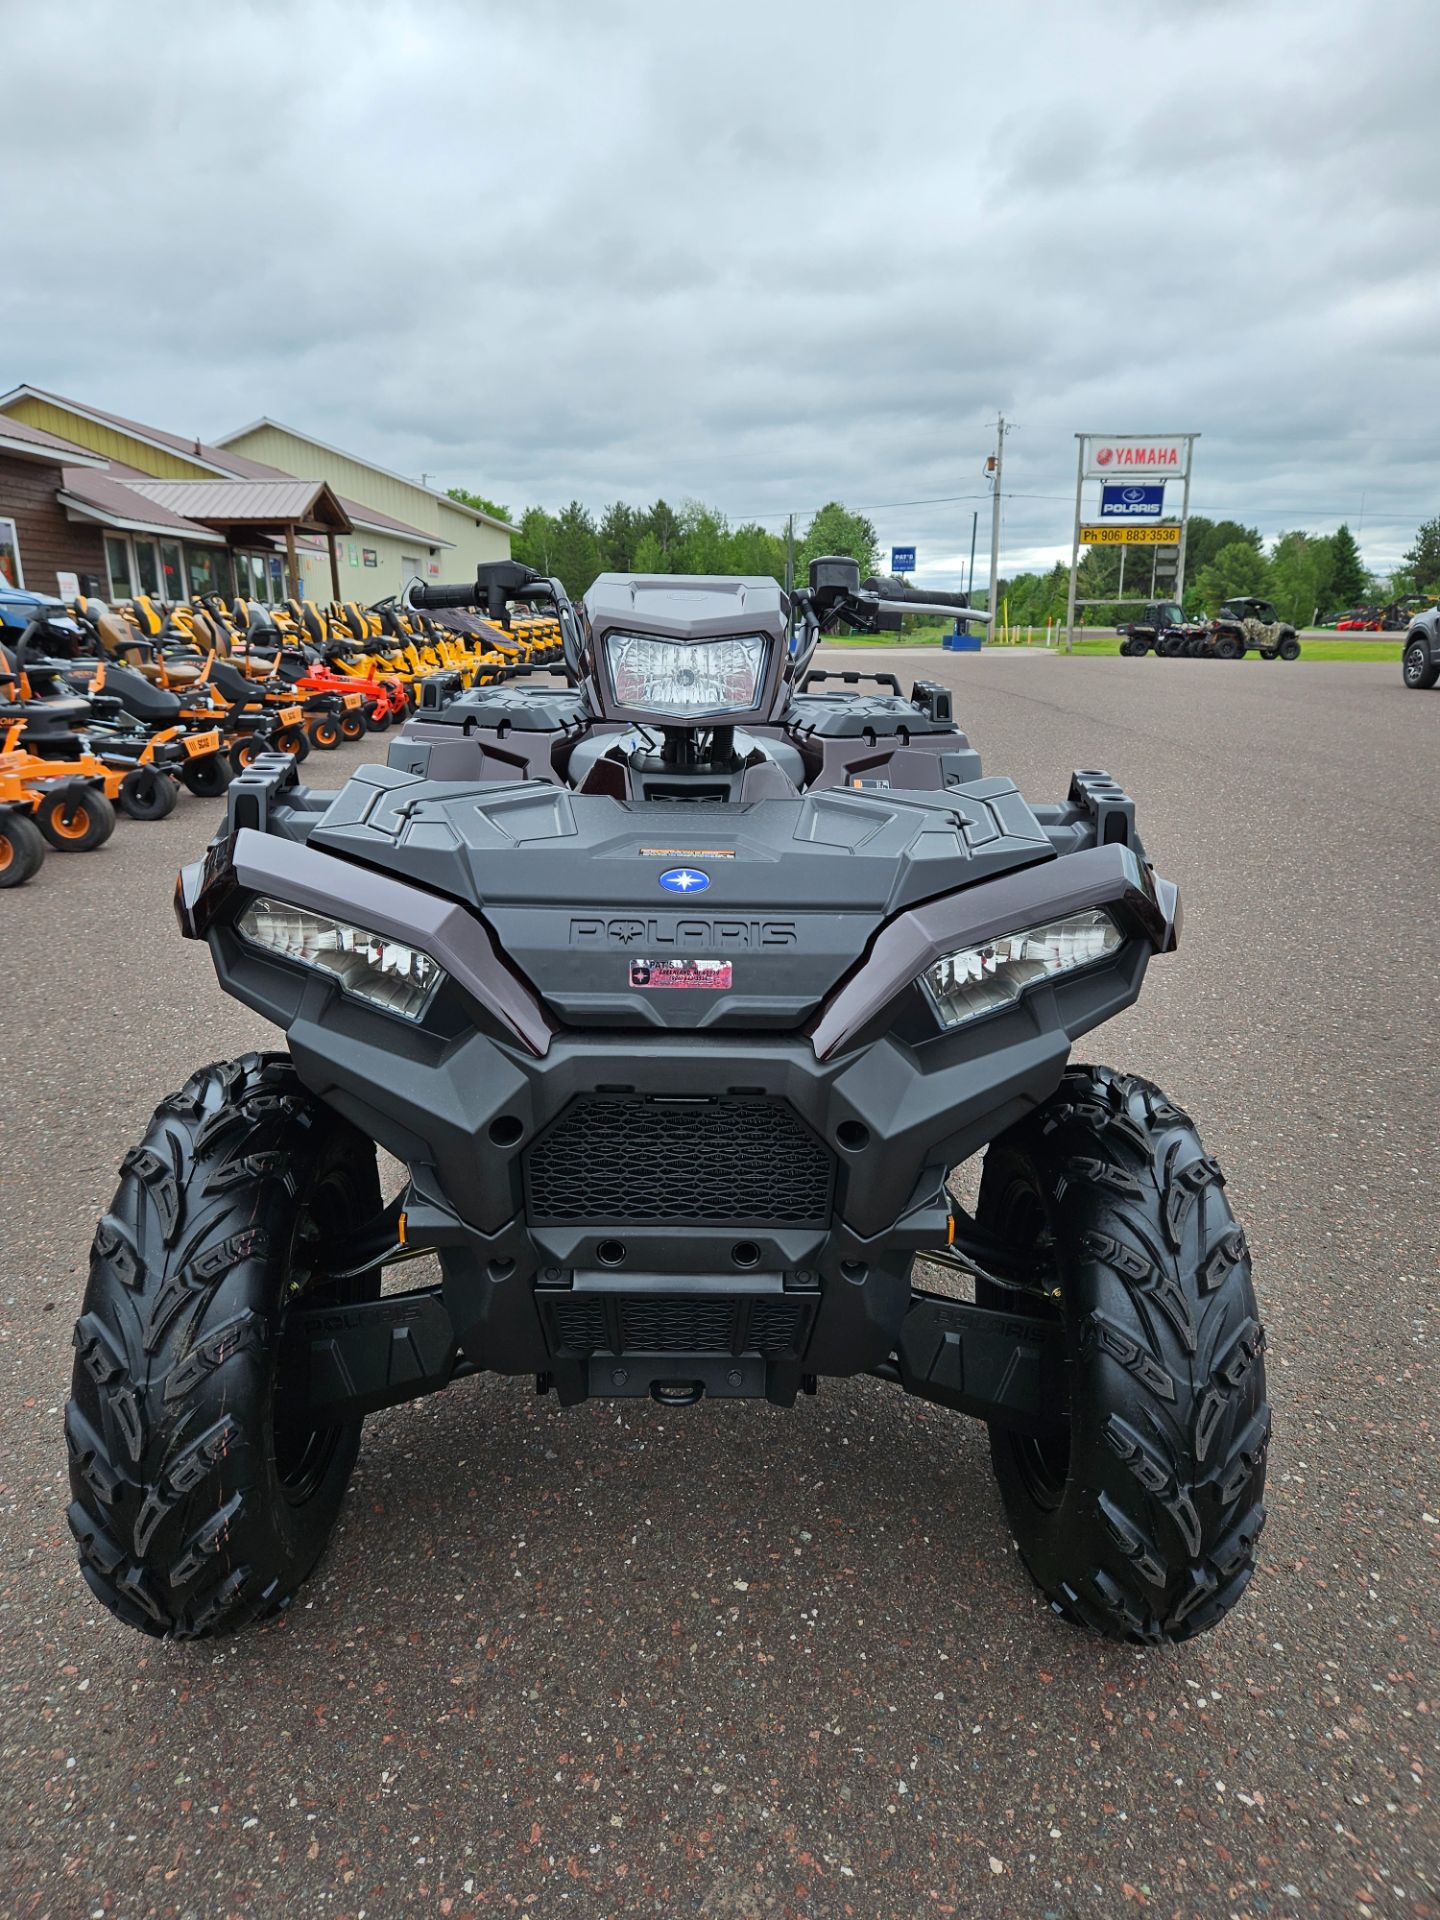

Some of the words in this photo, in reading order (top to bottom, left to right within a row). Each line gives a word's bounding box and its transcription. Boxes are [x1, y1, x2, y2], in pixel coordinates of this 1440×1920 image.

[1116, 448, 1177, 465] YAMAHA
[1103, 504, 1161, 513] POLARIS
[1083, 530, 1098, 541] Ph
[1126, 530, 1176, 541] 883-3536
[568, 918, 798, 947] POLARIS
